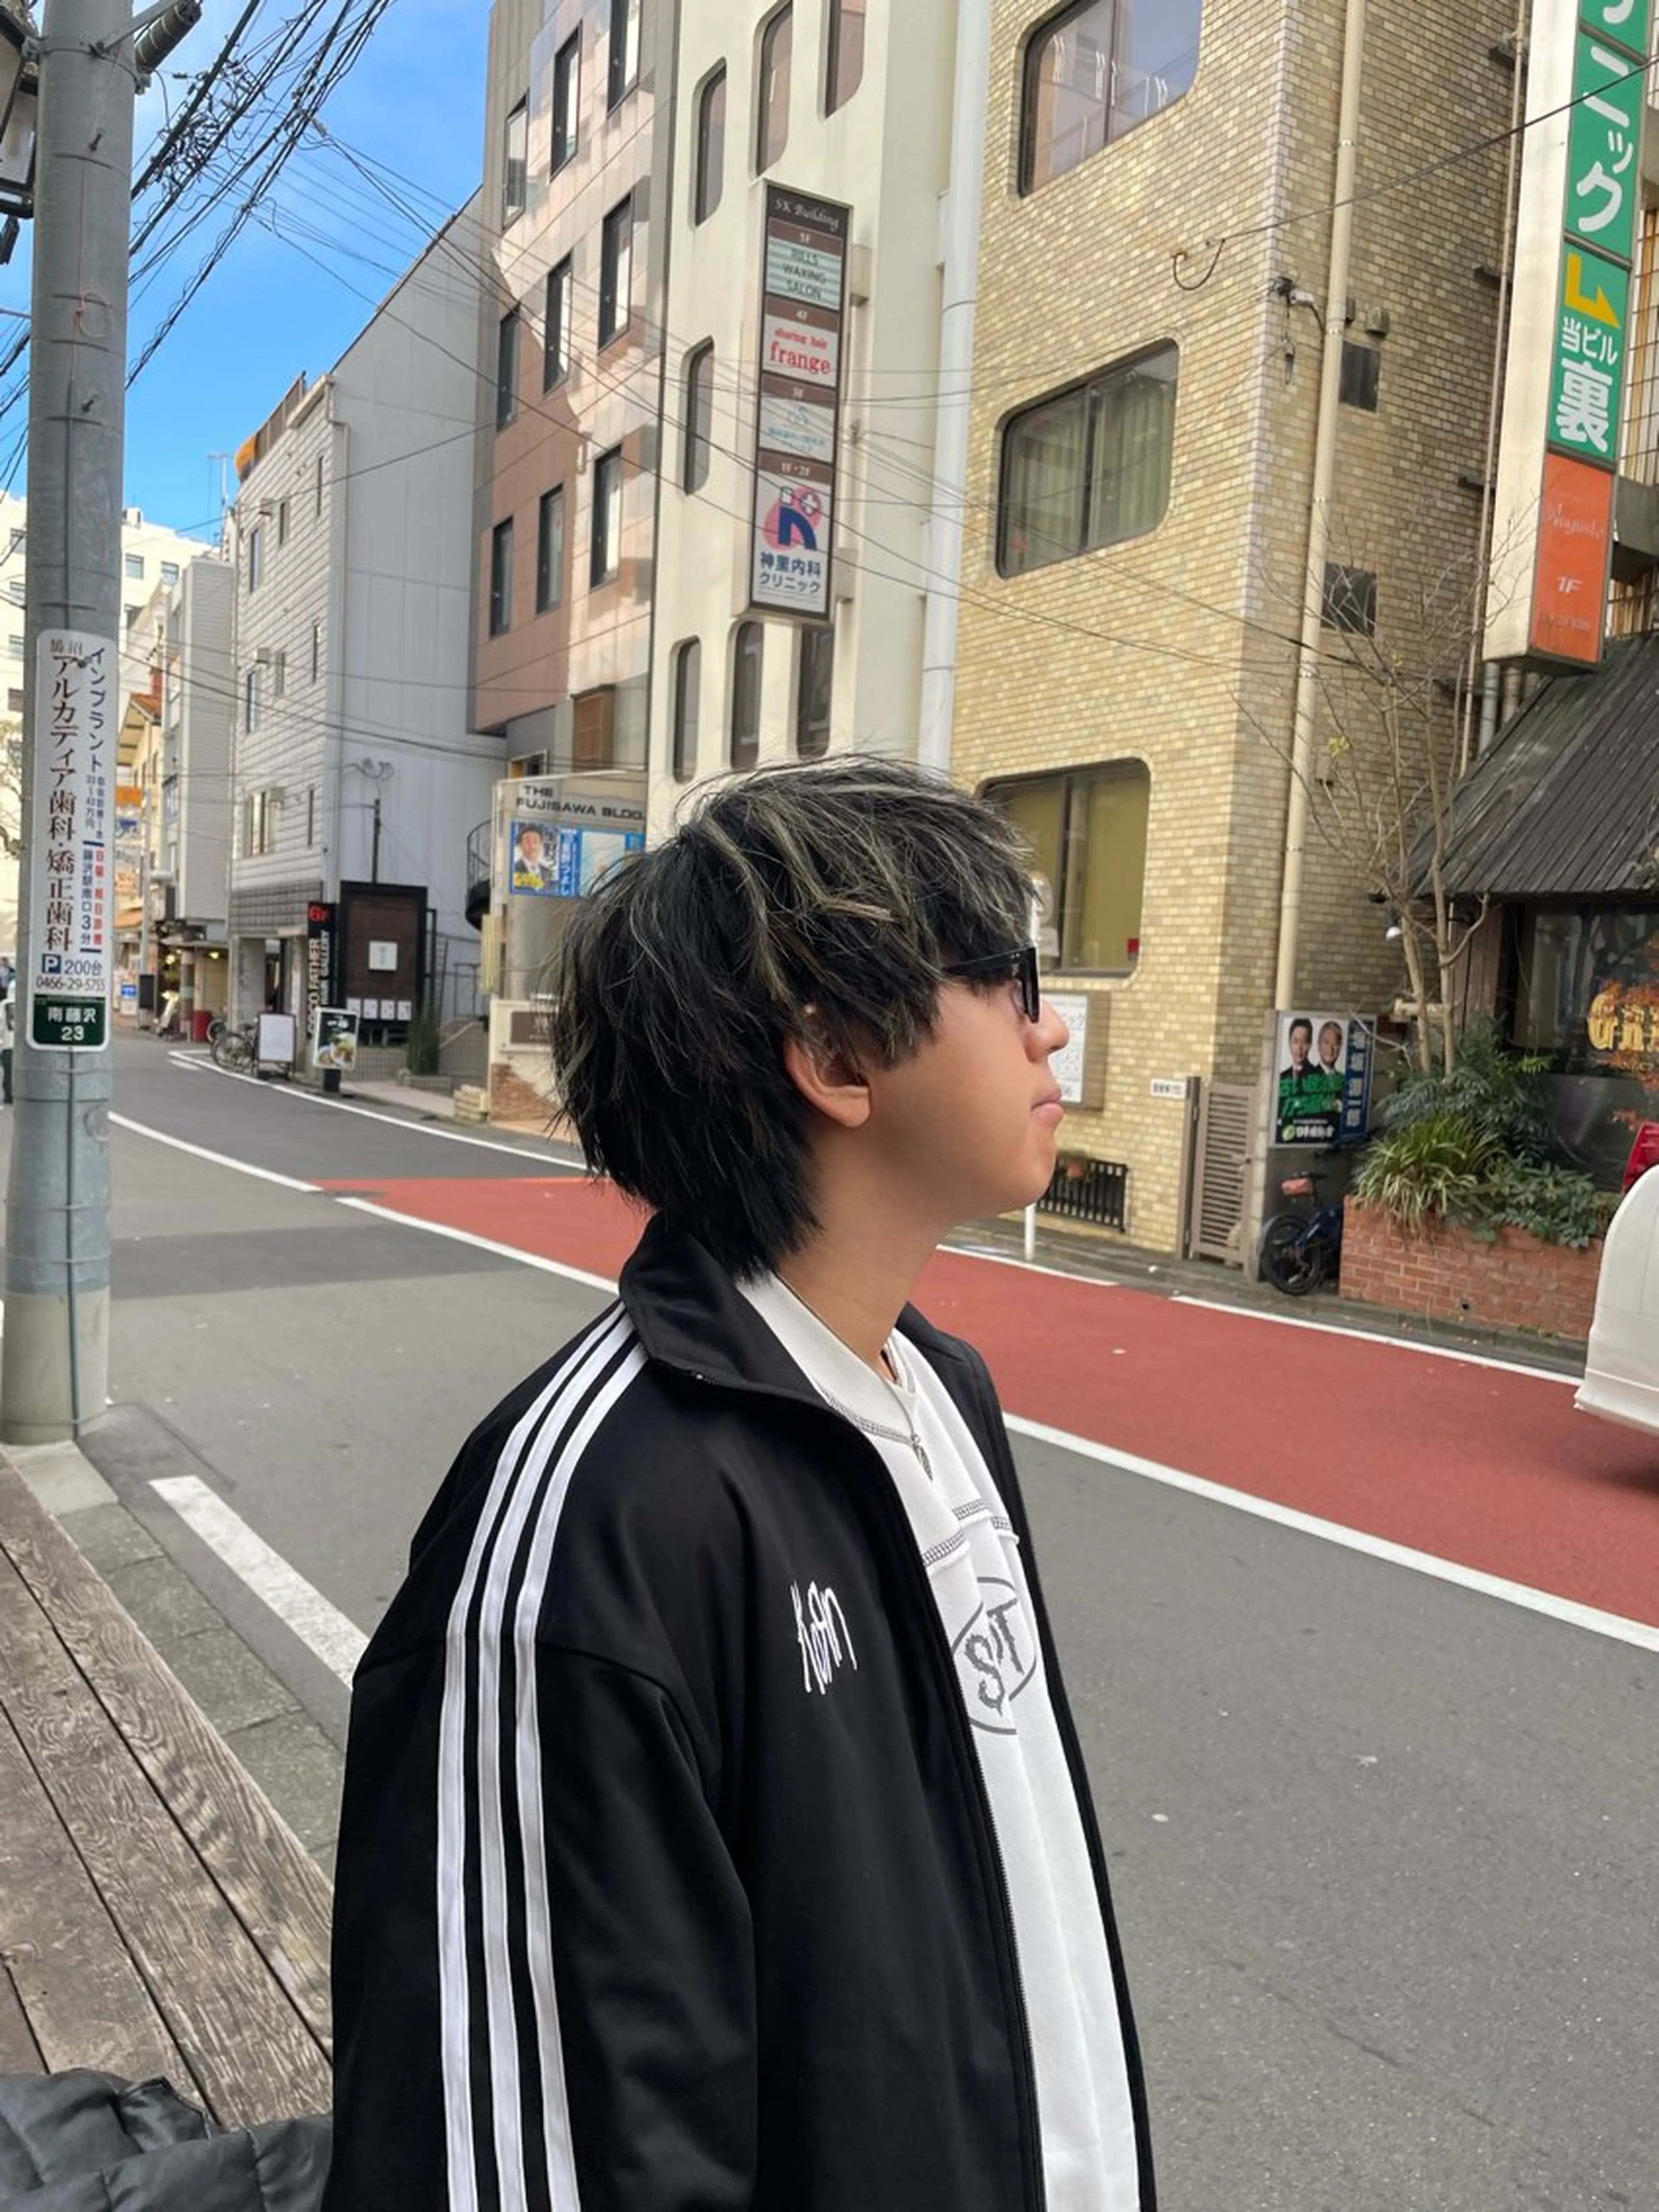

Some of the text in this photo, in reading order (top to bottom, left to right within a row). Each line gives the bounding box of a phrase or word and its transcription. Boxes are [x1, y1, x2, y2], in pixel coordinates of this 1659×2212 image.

[1576, 0, 1634, 232] ニック
[782, 263, 826, 286] WAXING
[786, 279, 822, 302] SALON
[1561, 316, 1618, 365] 当ビル
[769, 340, 831, 375] frange
[1555, 358, 1613, 453] 裏
[759, 572, 820, 594] クリニック
[1557, 575, 1585, 594] 1F
[523, 785, 554, 798] THE
[515, 798, 597, 817] FUJISAWA
[64, 958, 102, 976] 200台
[308, 938, 321, 990] FATHER
[48, 1006, 96, 1023] 南藤沢
[61, 1025, 85, 1041] 23
